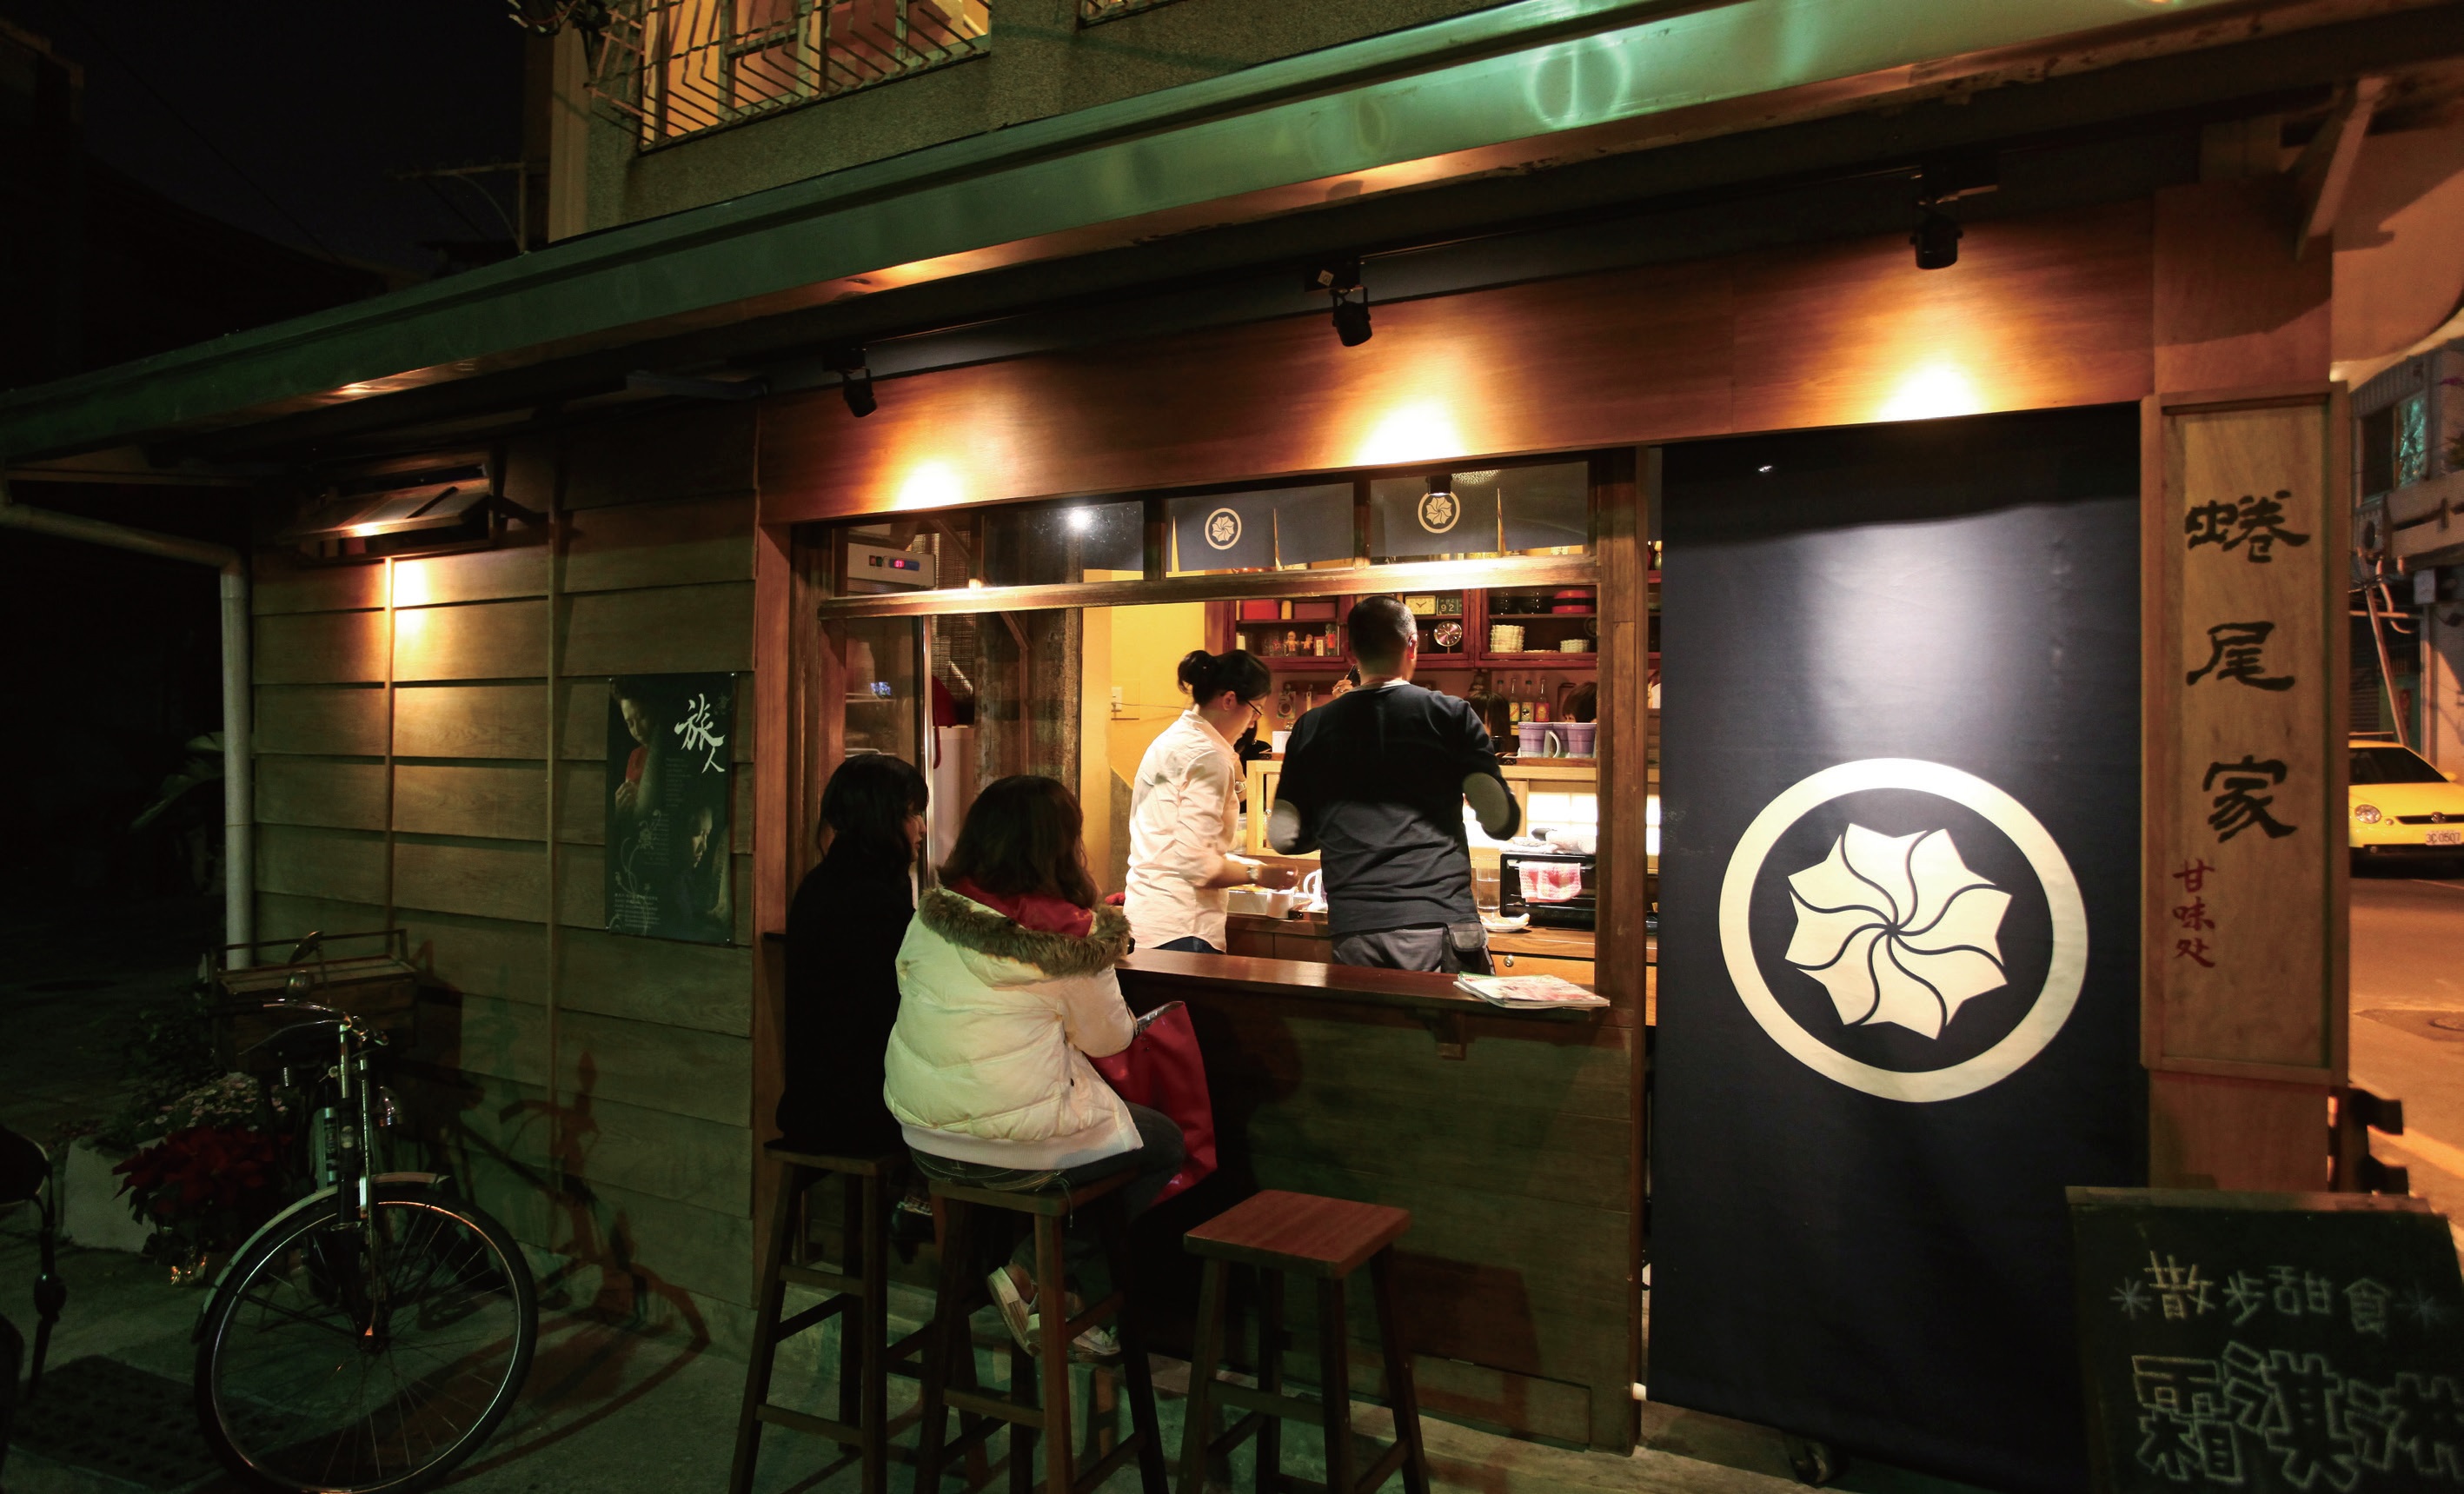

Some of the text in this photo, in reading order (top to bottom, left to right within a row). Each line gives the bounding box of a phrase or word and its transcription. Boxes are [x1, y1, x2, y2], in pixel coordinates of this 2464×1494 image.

[2184, 489, 2311, 843] 蜷尾家
[674, 693, 726, 774] 旅人
[2143, 1250, 2392, 1338] 散步甜食
